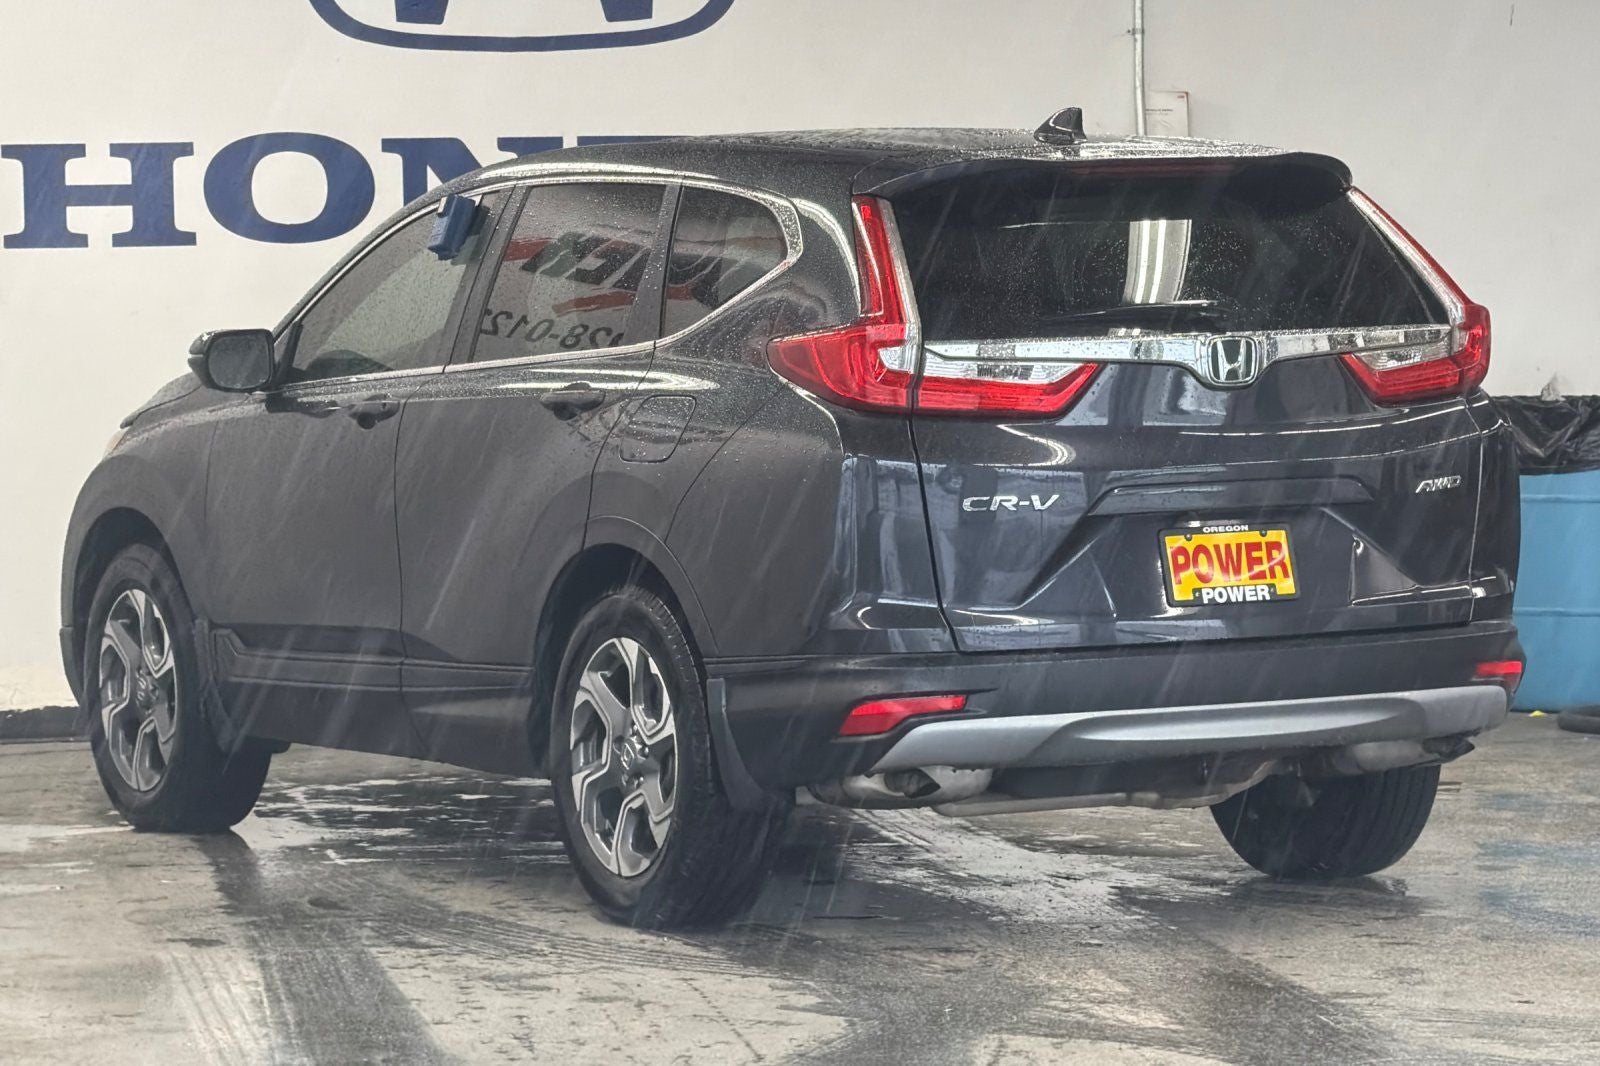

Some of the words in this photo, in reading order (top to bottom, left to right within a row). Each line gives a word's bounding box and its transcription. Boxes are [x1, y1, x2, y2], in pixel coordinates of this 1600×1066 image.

[1, 132, 688, 249] HON
[1415, 475, 1461, 493] AWD
[962, 494, 1060, 512] CR-V
[1203, 524, 1249, 533] OREGON
[1170, 540, 1291, 585] POWER
[1201, 584, 1271, 604] POWER
